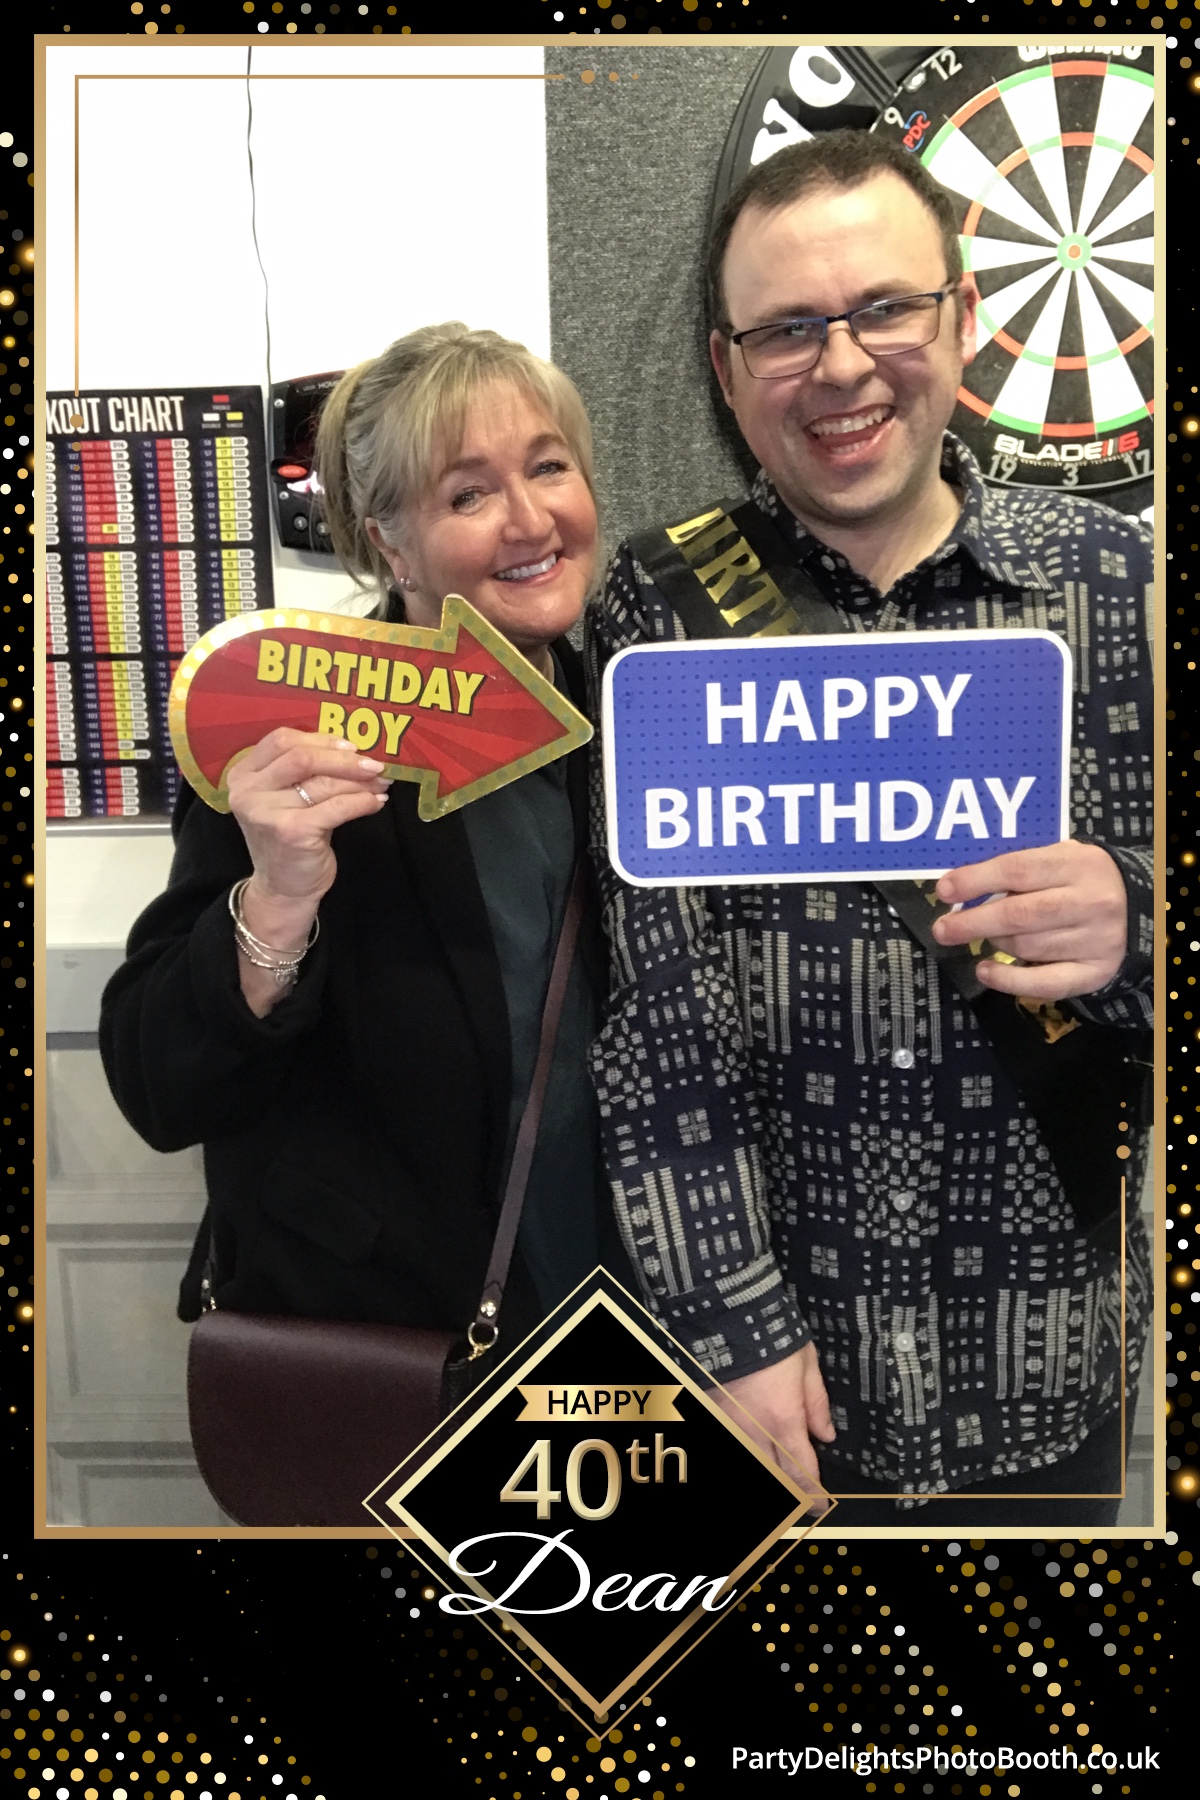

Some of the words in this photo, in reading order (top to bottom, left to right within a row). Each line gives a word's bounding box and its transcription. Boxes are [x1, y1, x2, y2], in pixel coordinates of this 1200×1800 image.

[930, 50, 963, 81] 12
[884, 107, 905, 129] 9
[903, 115, 931, 149] PDC
[108, 396, 184, 432] CHART
[989, 454, 1017, 482] 19
[1062, 463, 1080, 488] 3
[1123, 449, 1150, 478] 17
[256, 638, 485, 716] BIRTHDAY
[705, 673, 973, 745] HAPPY
[317, 702, 413, 756] BOY
[645, 776, 1037, 850] BIRTHDAY
